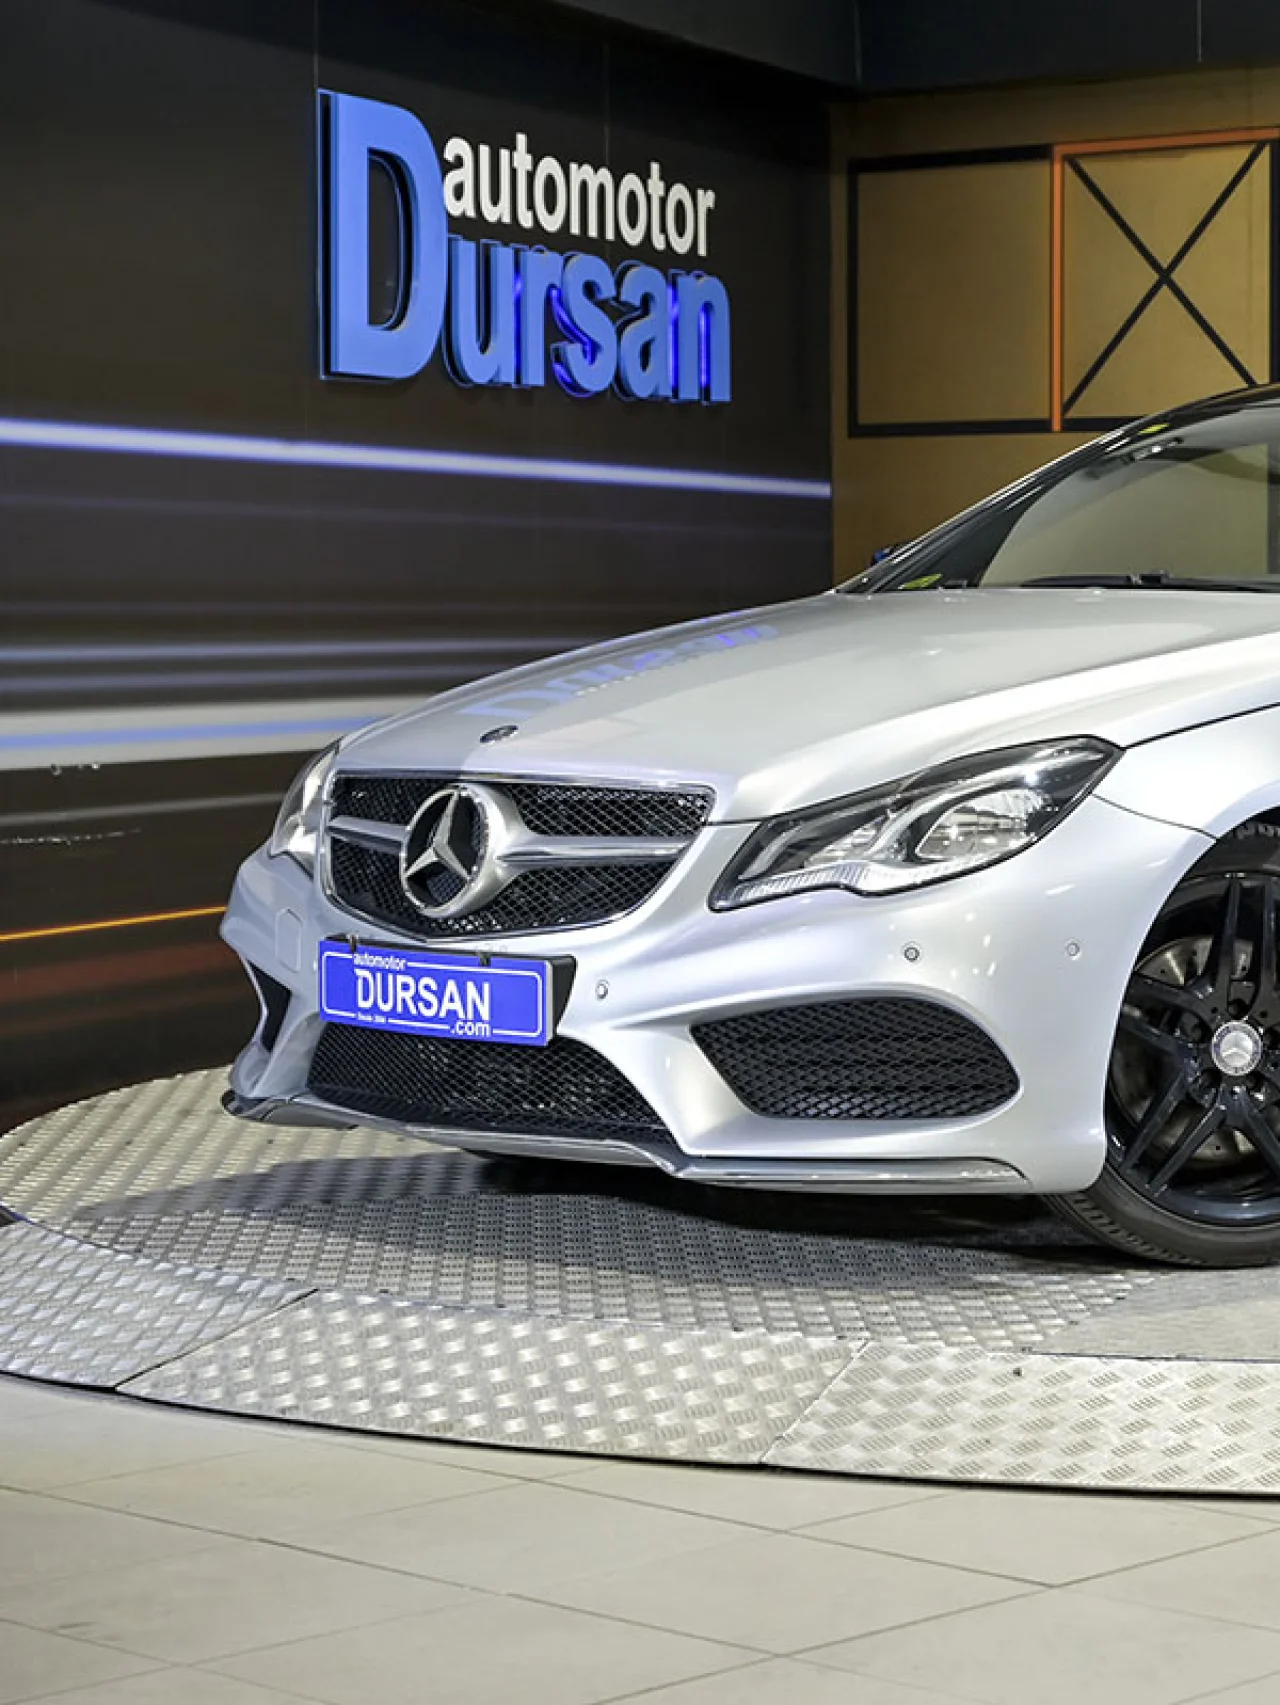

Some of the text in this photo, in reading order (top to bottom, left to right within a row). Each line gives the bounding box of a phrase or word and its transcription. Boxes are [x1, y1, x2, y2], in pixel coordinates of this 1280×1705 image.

[443, 132, 716, 257] automotor
[318, 88, 732, 405] Dursan
[353, 952, 406, 971] automotor
[354, 968, 490, 1021] DURSAN
[450, 1020, 491, 1037] .com
